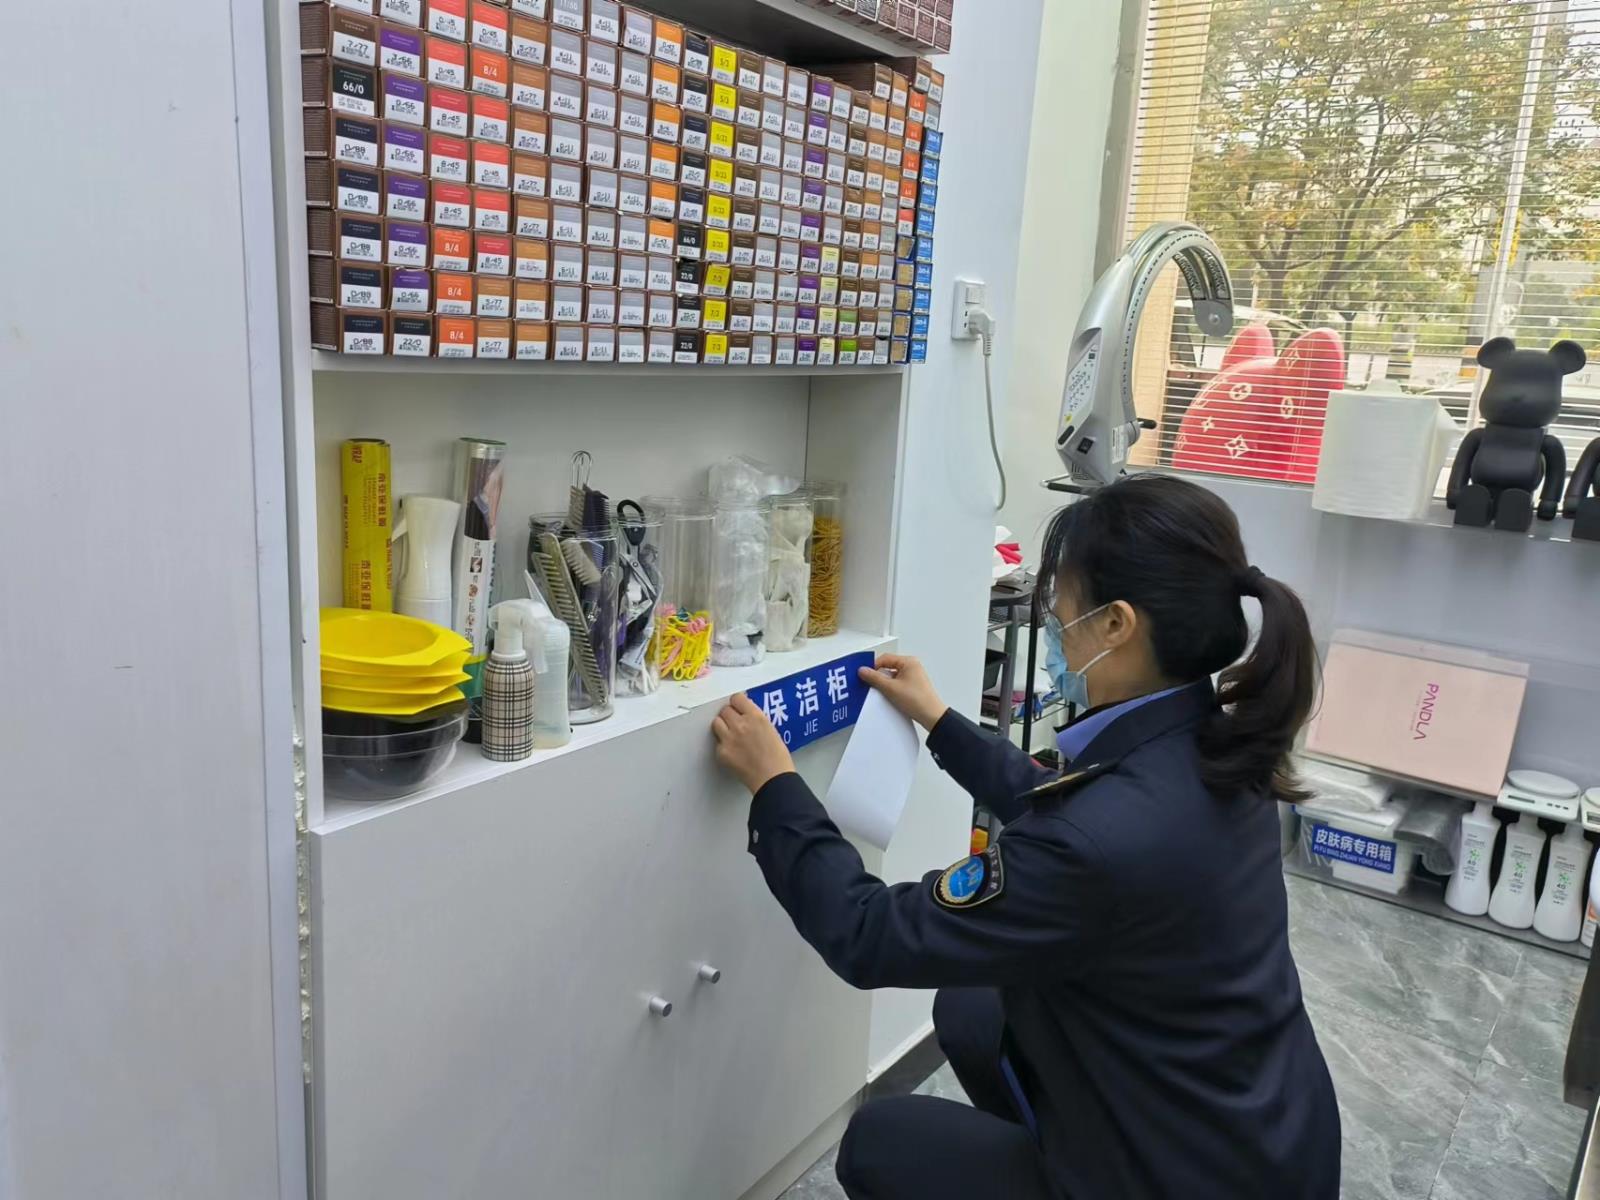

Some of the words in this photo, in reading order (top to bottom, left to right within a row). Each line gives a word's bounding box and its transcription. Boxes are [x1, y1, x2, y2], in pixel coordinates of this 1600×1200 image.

[483, 65, 497, 77] 8/4
[342, 81, 365, 95] 66/0
[444, 242, 460, 254] 8/4
[447, 287, 463, 297] 8/4
[449, 331, 465, 341] 8/4
[763, 666, 849, 727] 保洁柜
[1413, 683, 1440, 740] PANDLA
[803, 718, 818, 736] JIE
[832, 705, 848, 723] GUI
[1316, 829, 1391, 861] 皮肤病专用箱
